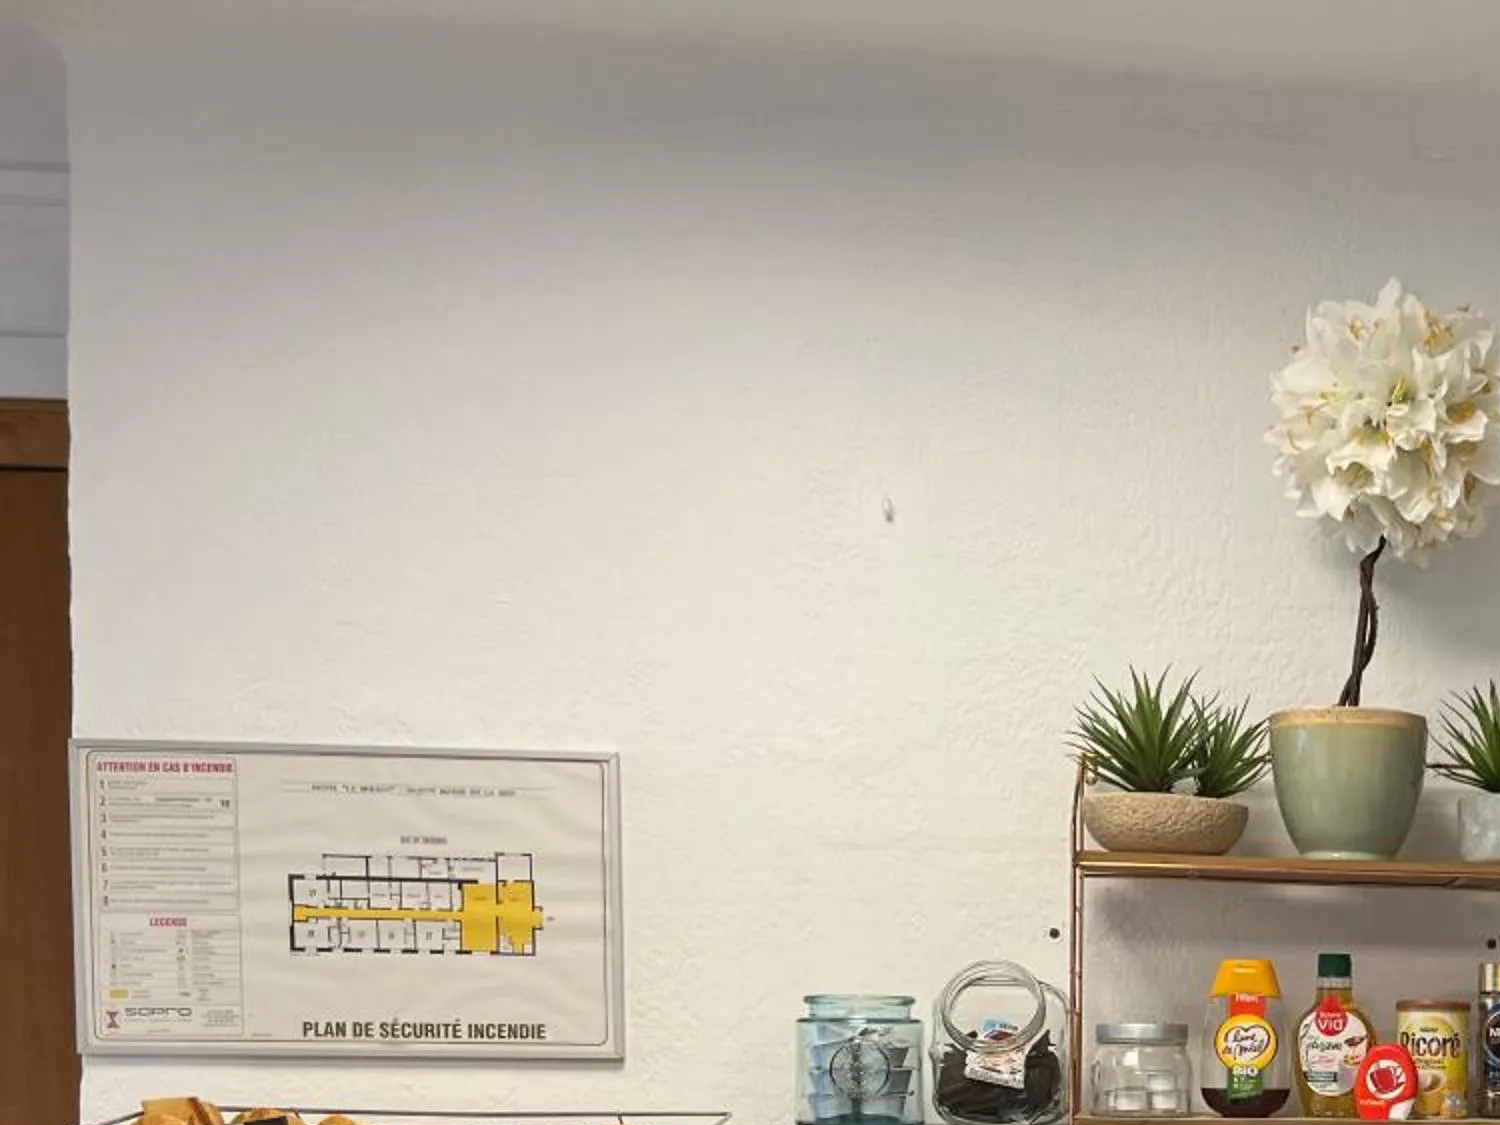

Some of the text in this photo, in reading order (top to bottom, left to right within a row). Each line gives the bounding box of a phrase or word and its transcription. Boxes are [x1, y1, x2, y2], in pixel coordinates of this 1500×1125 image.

[303, 1018, 547, 1040] PLAN DE SÉCURITÉ INCENDIE
[1400, 1031, 1461, 1058] Ricoré
